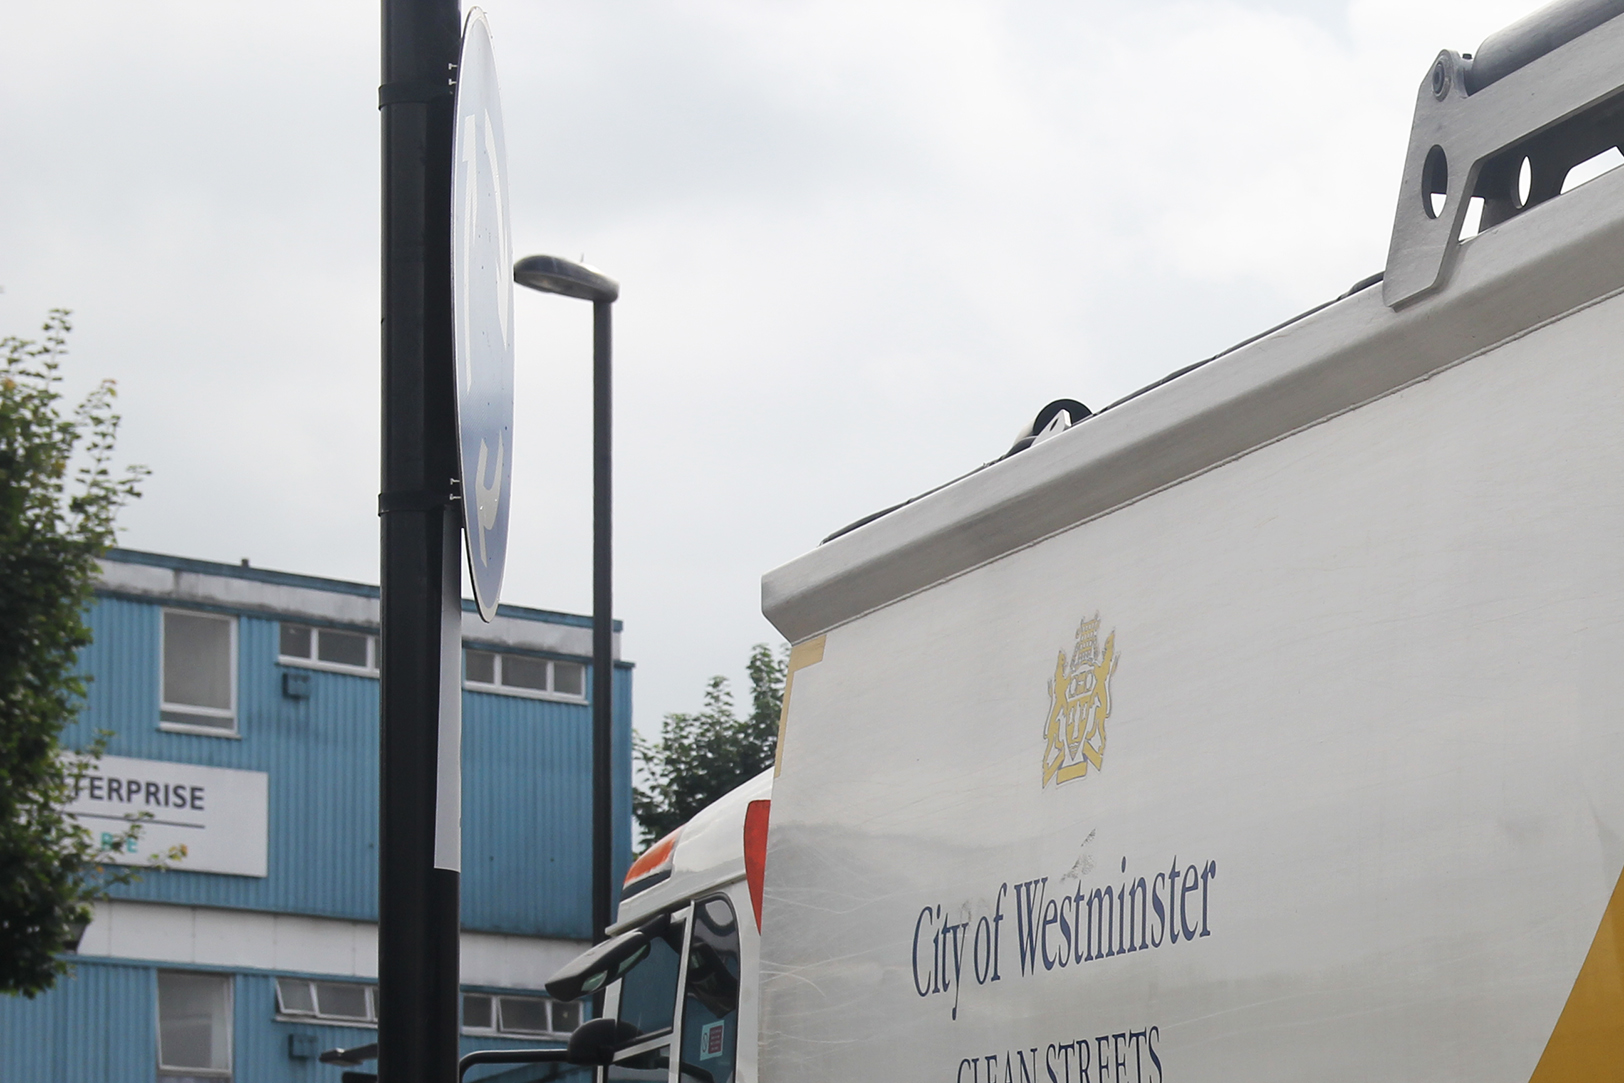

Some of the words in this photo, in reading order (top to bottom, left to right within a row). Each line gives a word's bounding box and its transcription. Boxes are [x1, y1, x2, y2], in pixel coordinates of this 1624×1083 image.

[64, 774, 205, 811] TERPRISE
[912, 904, 969, 1021] City
[973, 882, 1008, 985] of
[1014, 855, 1217, 978] Westminster
